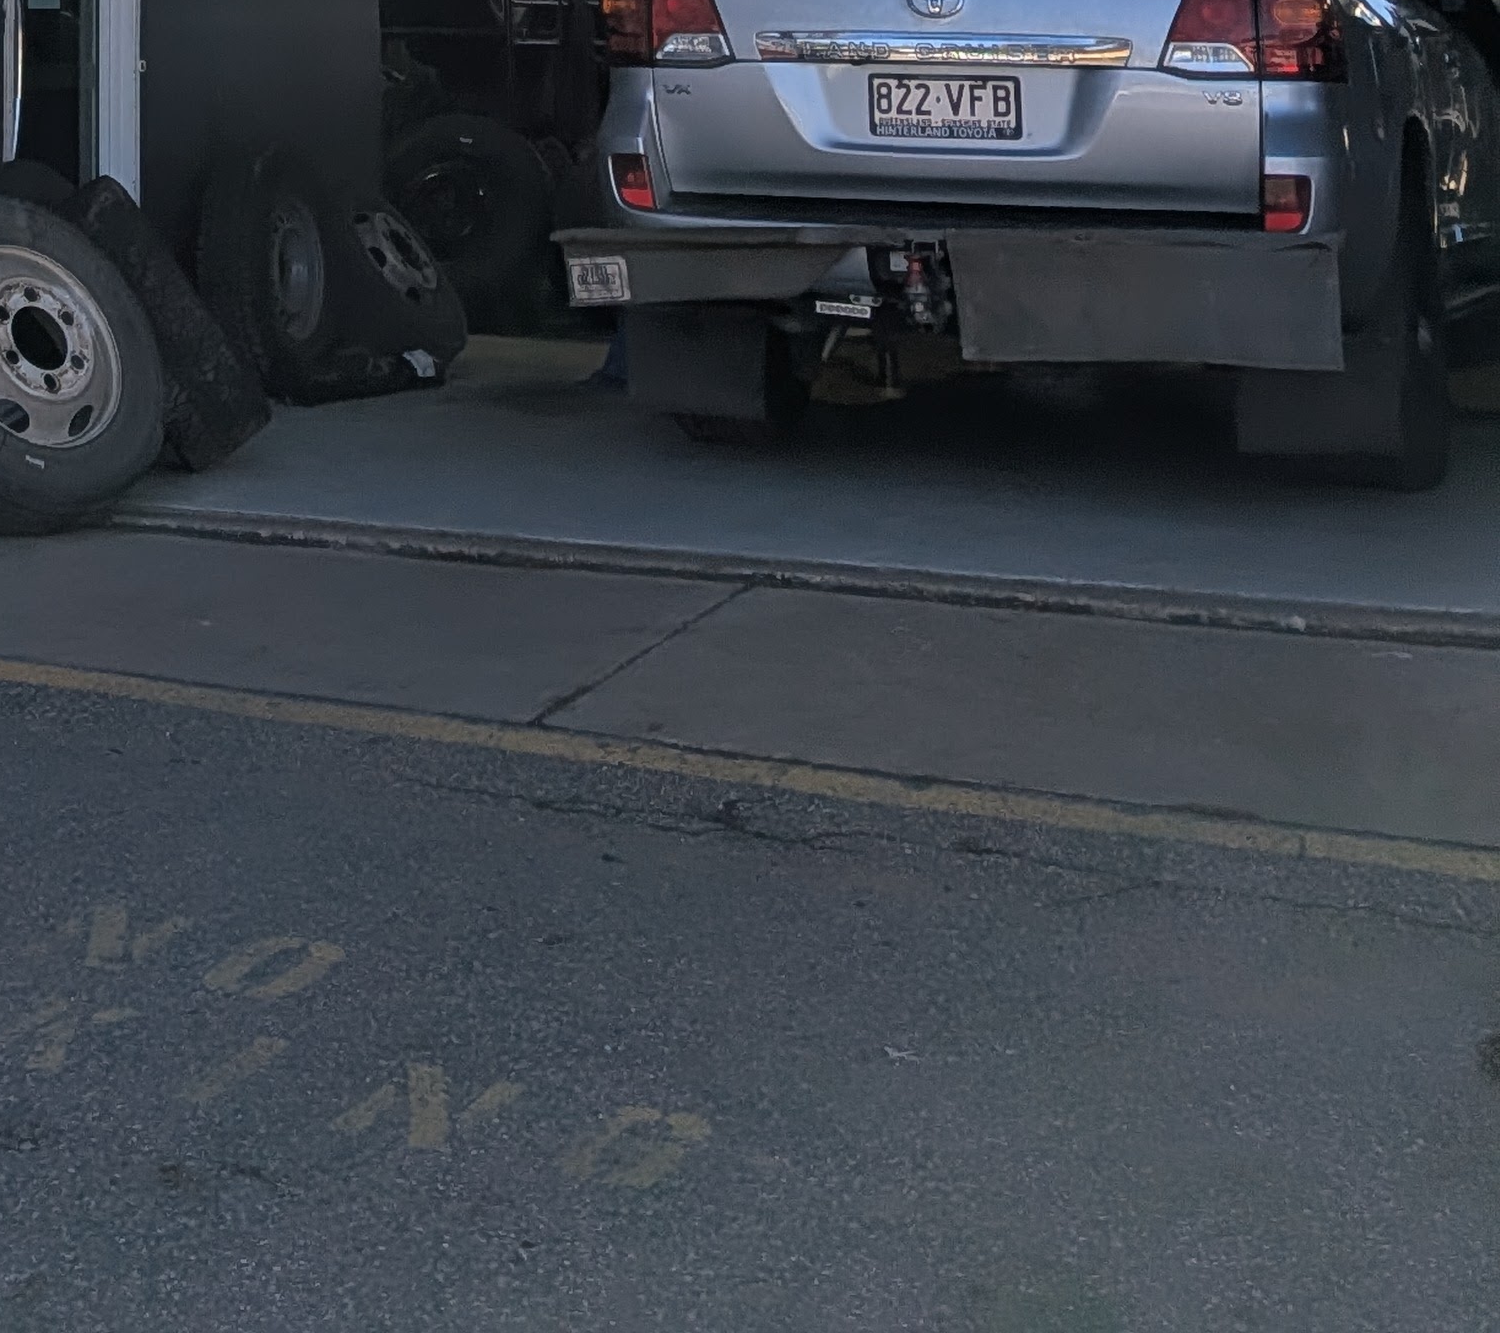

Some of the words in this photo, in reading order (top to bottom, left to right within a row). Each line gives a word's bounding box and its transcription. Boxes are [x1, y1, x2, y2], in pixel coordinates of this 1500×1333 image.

[803, 42, 891, 60] LAND
[914, 42, 1077, 64] CRUISER
[1202, 90, 1243, 106] V8
[876, 125, 950, 137] HINTERLAND
[952, 127, 997, 139] TOYOTA
